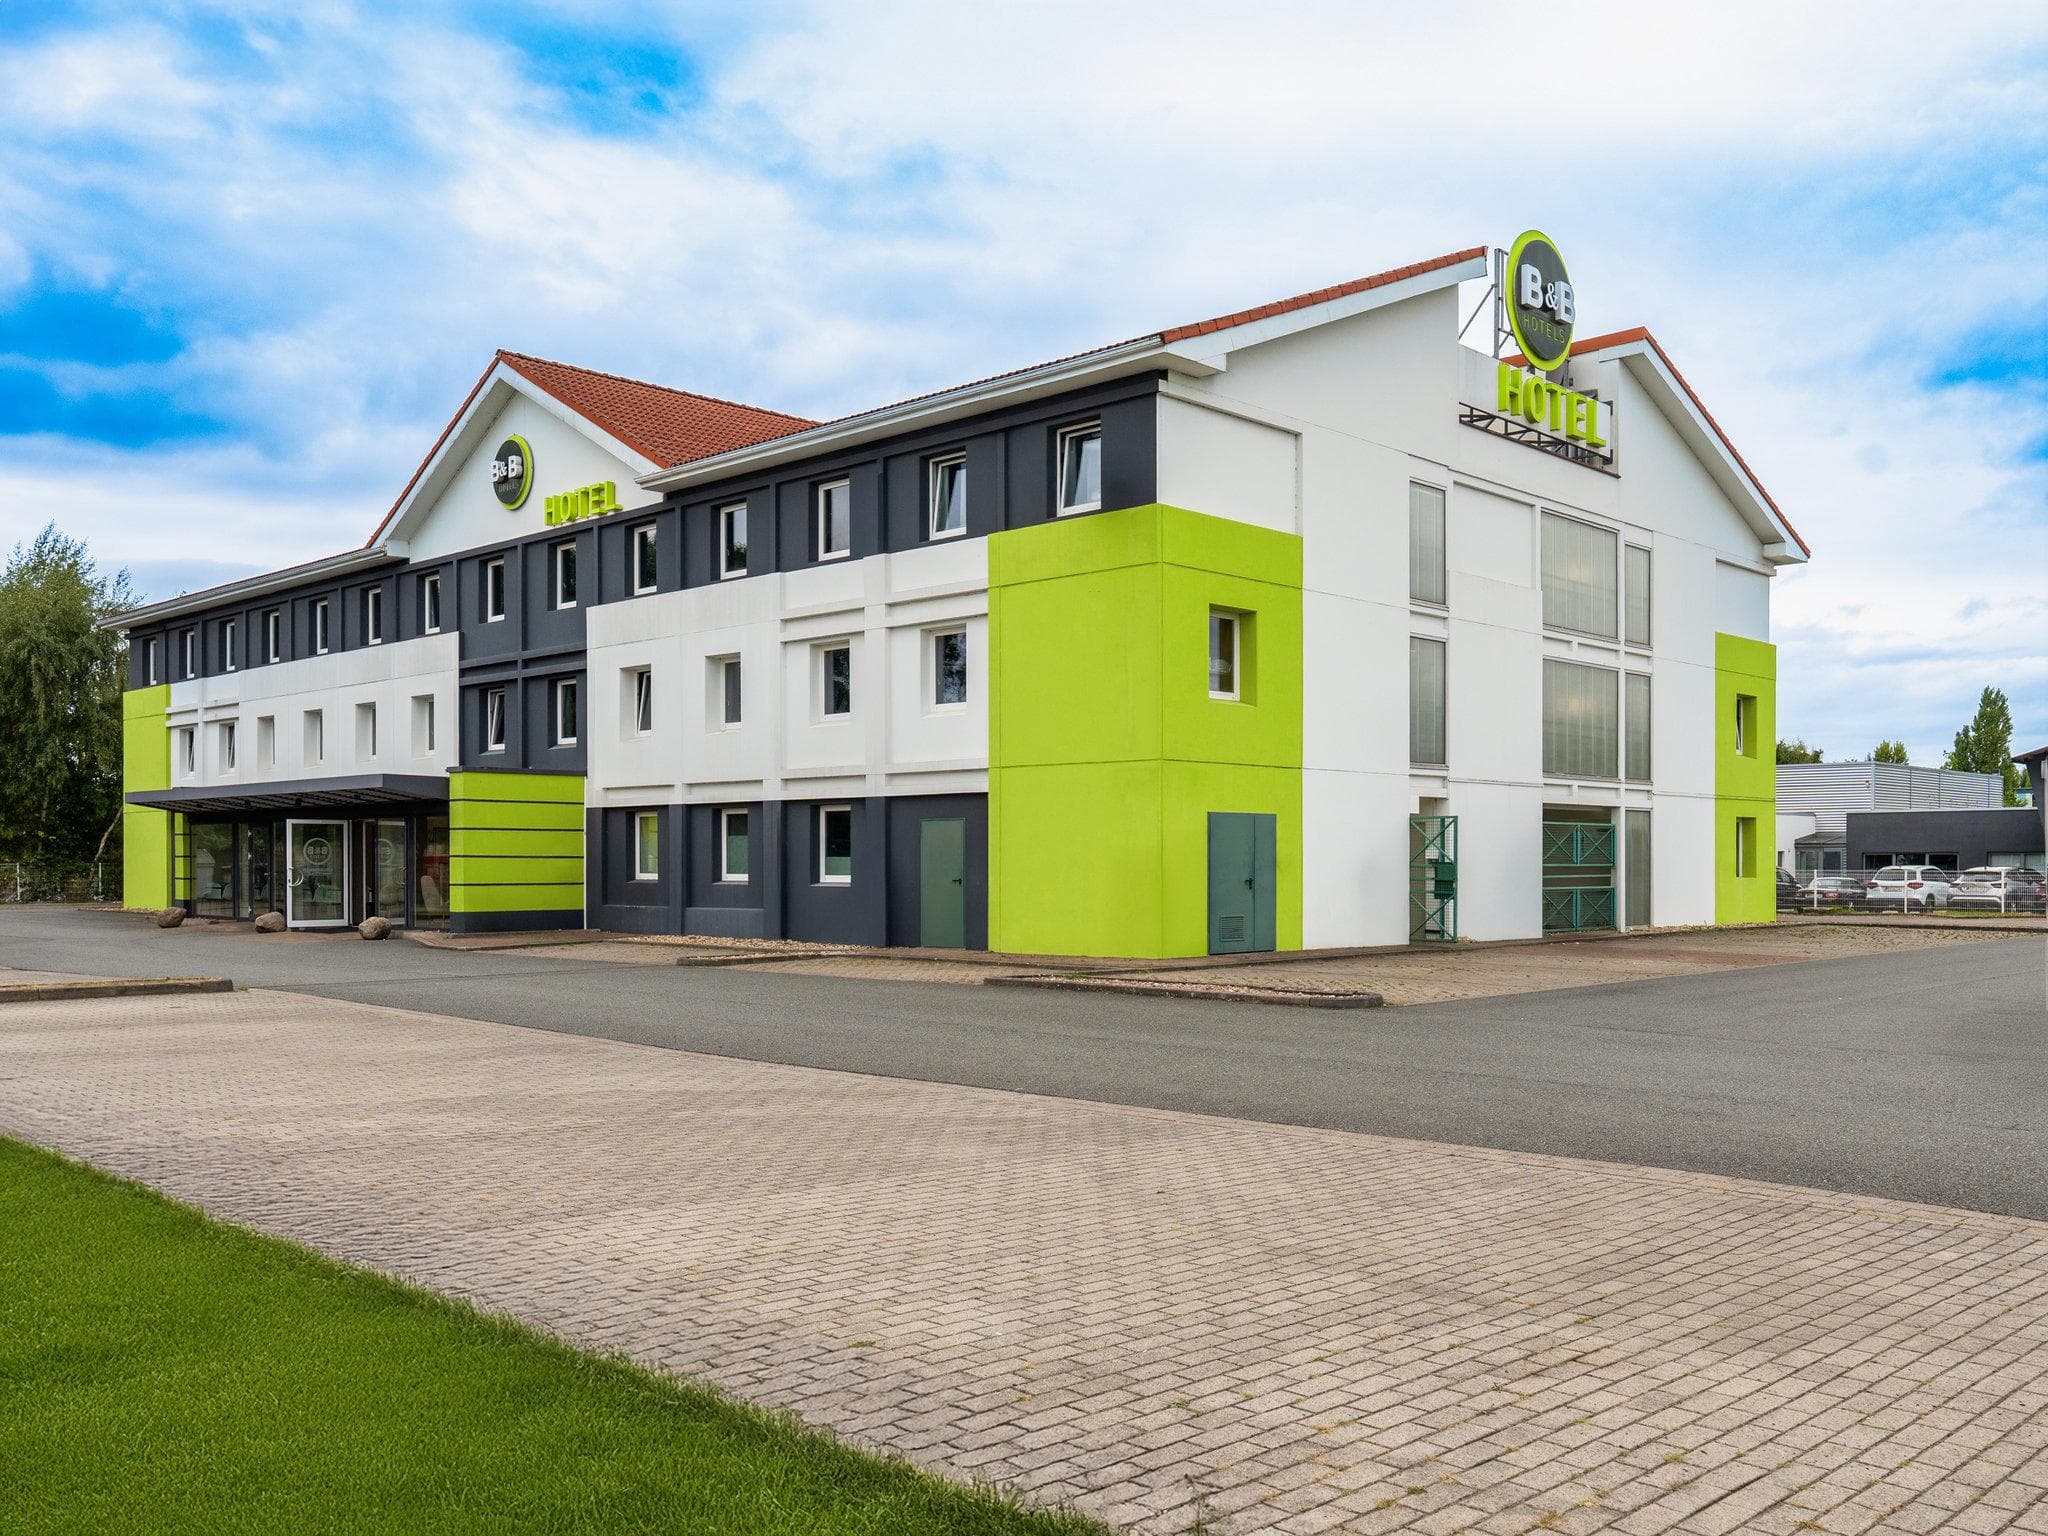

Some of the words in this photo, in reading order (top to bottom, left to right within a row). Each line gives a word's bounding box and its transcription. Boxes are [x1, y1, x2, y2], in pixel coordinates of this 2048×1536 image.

[1521, 264, 1575, 324] B&B
[1523, 313, 1565, 343] HOTELS
[1498, 363, 1606, 448] HOTEL
[490, 455, 522, 482] B&B
[544, 481, 622, 526] HOTEL
